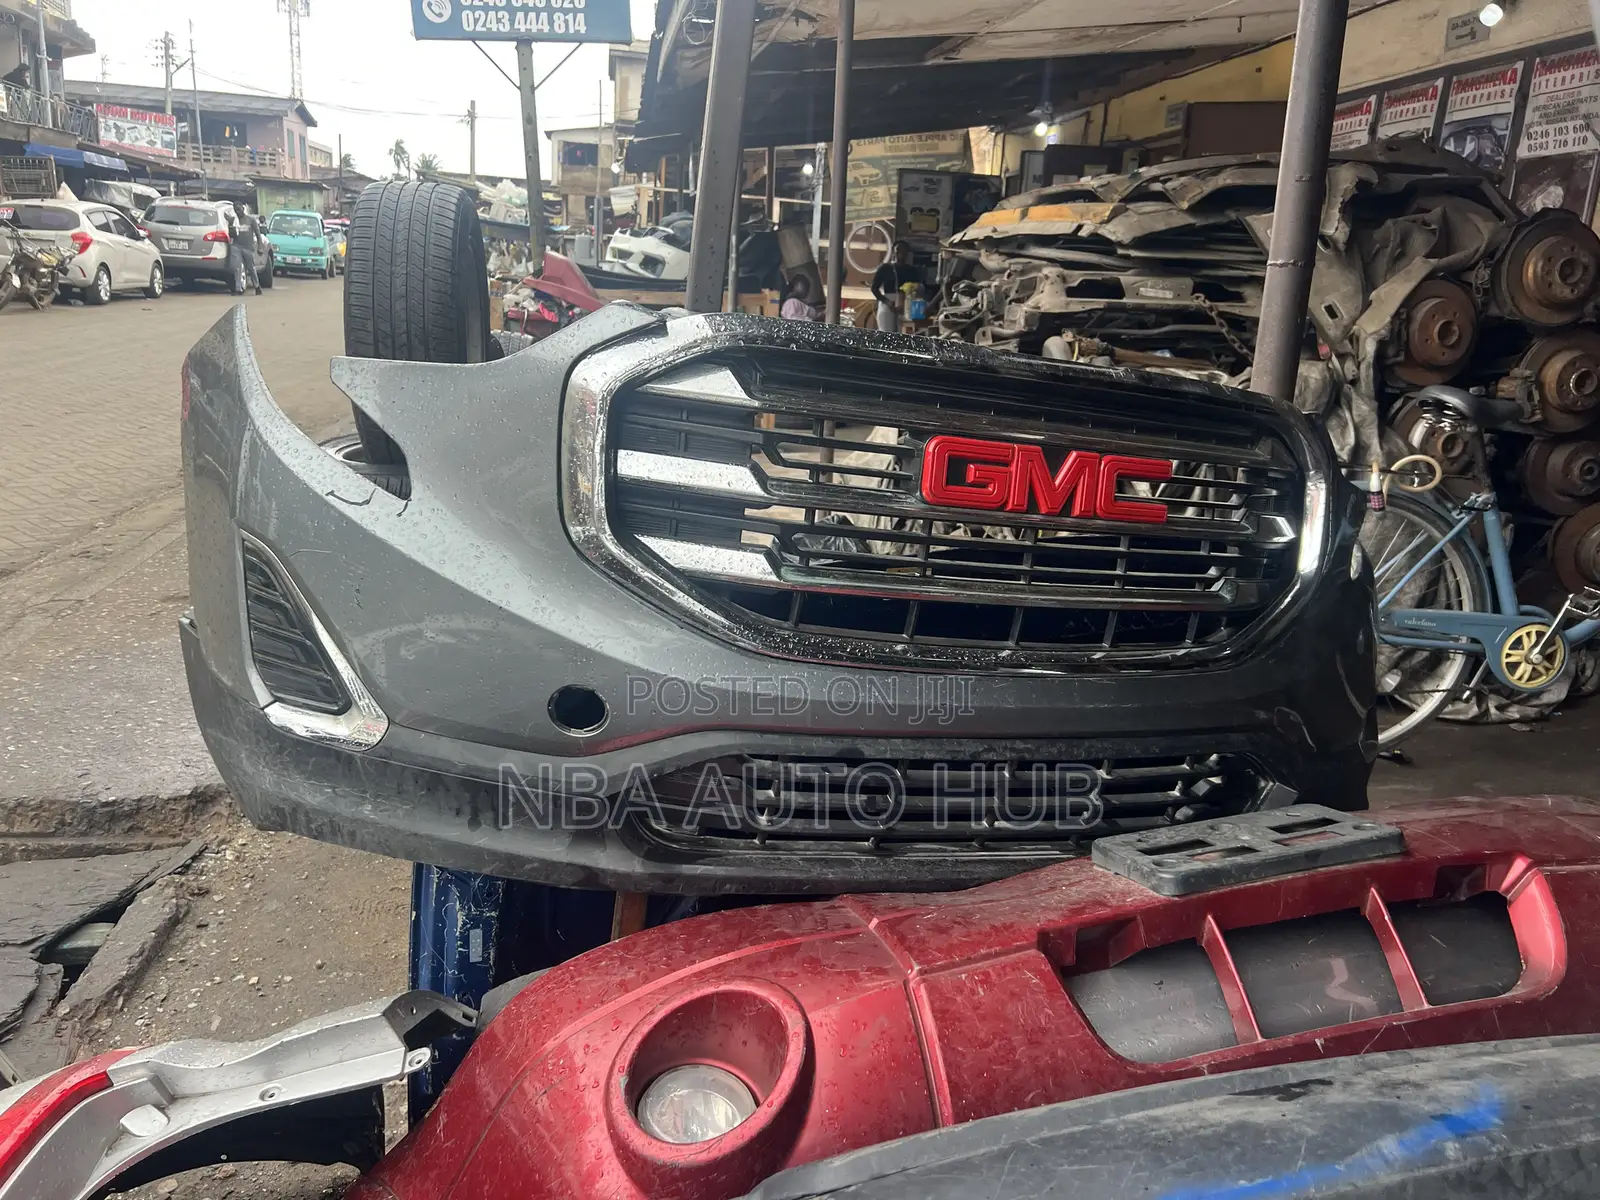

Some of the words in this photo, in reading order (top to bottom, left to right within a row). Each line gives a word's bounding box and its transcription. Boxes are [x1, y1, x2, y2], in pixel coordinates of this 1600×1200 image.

[461, 10, 510, 32] 0243
[514, 12, 549, 33] 444
[553, 13, 587, 34] 814
[1533, 68, 1600, 93] ENTERPRIS
[1527, 129, 1550, 142] 0246
[1553, 125, 1570, 138] 103
[1572, 122, 1590, 135] 600
[1527, 140, 1549, 153] 0593
[1553, 137, 1569, 150] 716
[1572, 134, 1588, 147] 110
[921, 435, 1173, 523] GMC
